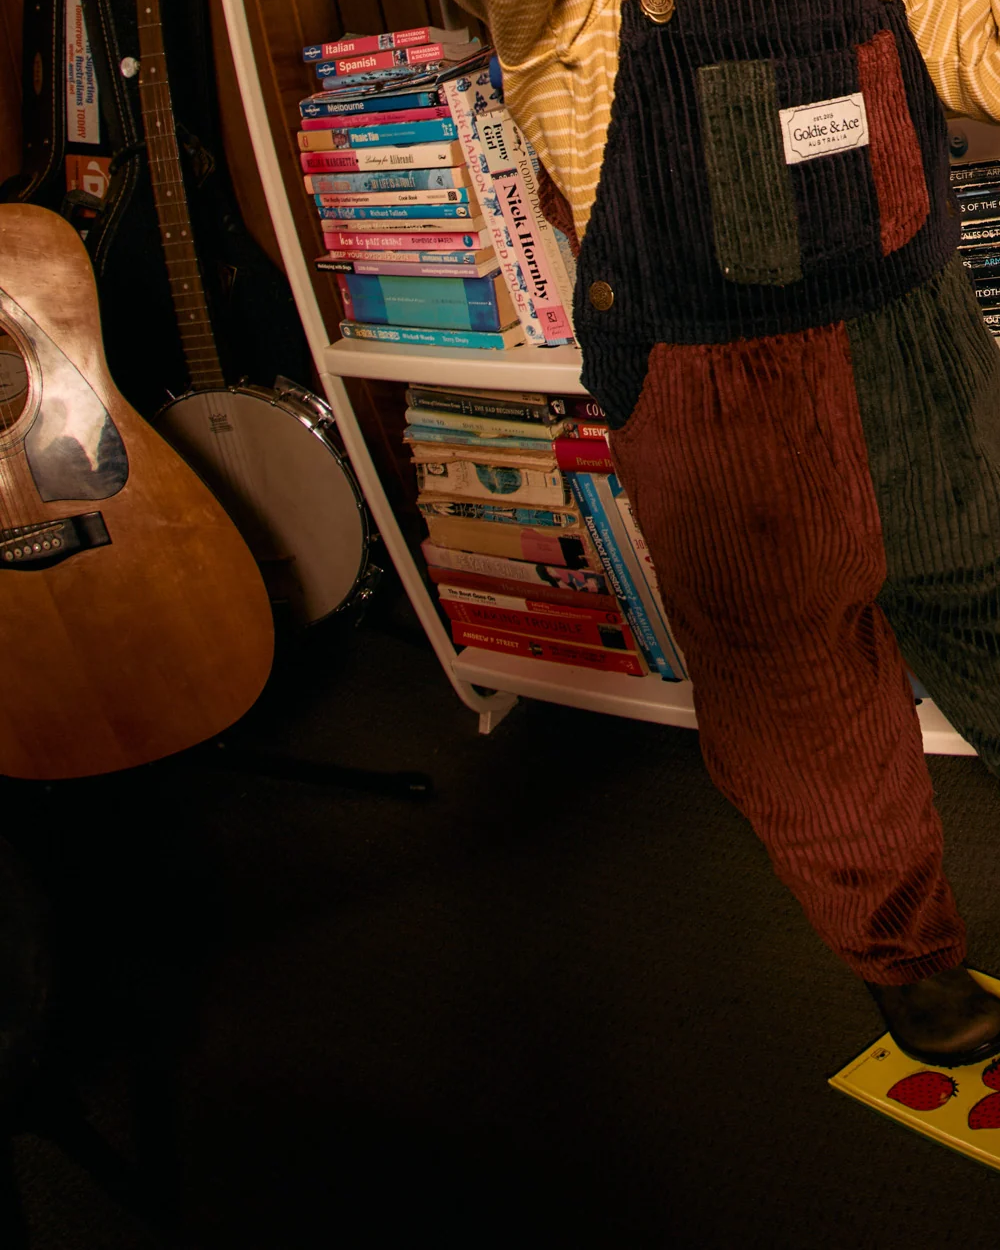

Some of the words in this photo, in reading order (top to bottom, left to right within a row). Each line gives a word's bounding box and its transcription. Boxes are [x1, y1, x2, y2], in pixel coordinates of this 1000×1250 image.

[326, 42, 355, 55] Italian
[339, 57, 376, 72] Spanish
[483, 125, 497, 150] Girl
[794, 124, 826, 141] Goldie
[830, 120, 840, 133] &
[842, 118, 859, 131] Ace
[808, 134, 847, 147] AUSTRALIA
[493, 123, 509, 161] Funny
[503, 182, 528, 229] Nick
[519, 233, 549, 301] Hornby
